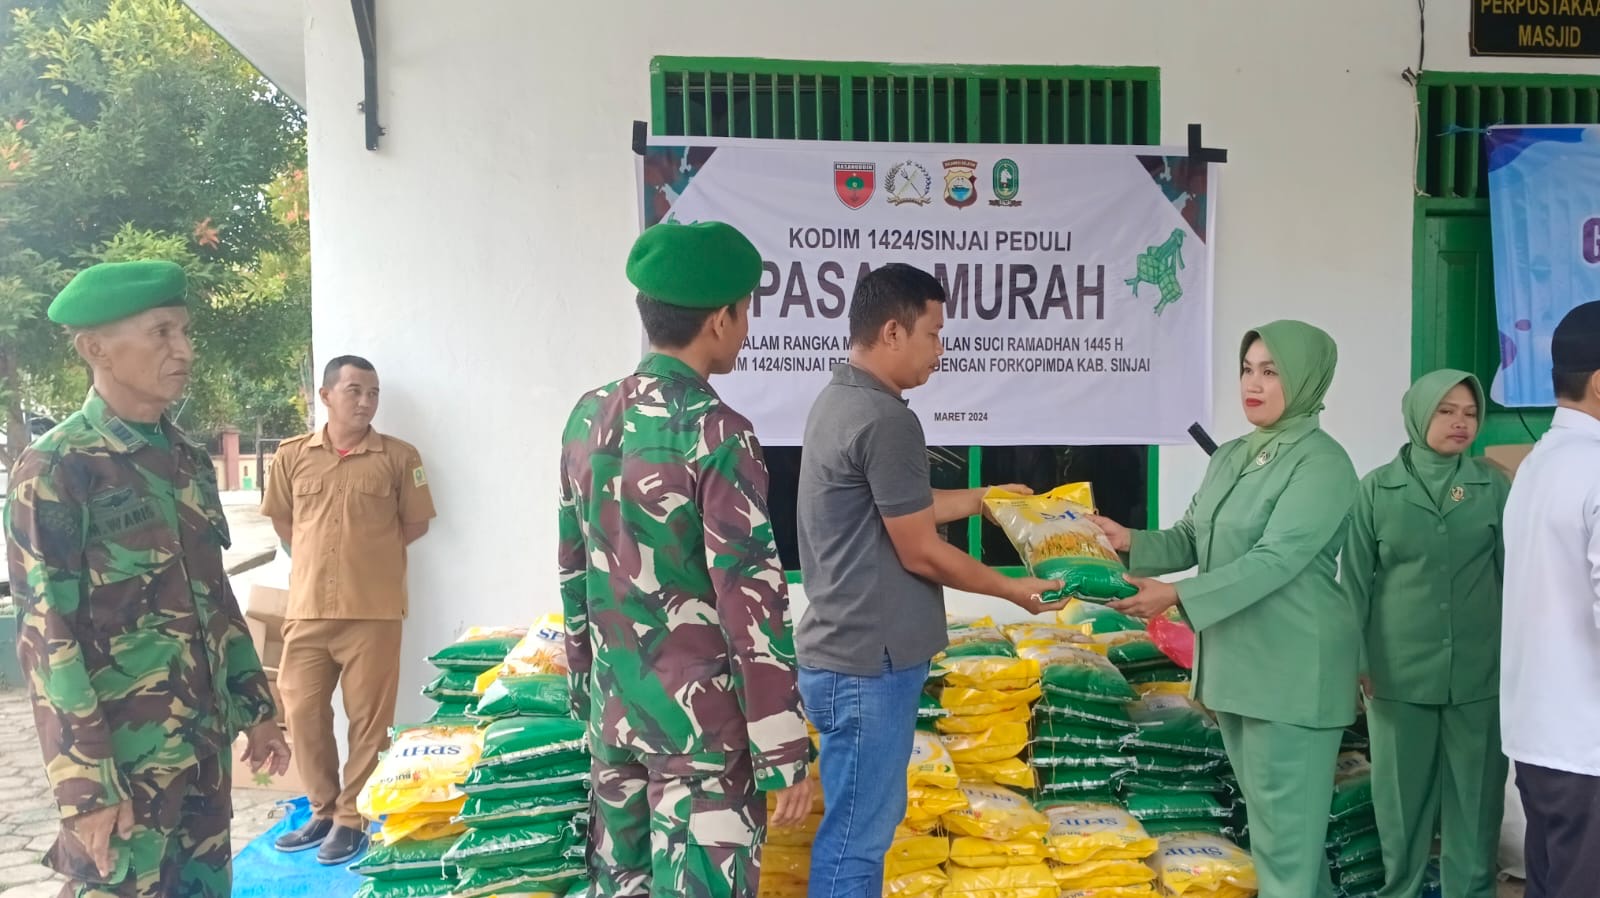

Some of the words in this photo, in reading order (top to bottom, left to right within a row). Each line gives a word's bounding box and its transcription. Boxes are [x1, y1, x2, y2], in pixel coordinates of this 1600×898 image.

[1519, 25, 1581, 47] MASJID
[789, 227, 860, 249] KODIM
[867, 229, 988, 251] 1424/SINJAI
[996, 231, 1072, 252] PEDULI
[752, 261, 873, 319] PAS
[934, 263, 1105, 320] MURAH
[742, 335, 780, 351] ALAM
[783, 336, 840, 351] RANGKA
[974, 337, 1004, 352] SUCI
[1007, 337, 1080, 352] RAMADHAN
[1084, 337, 1112, 352] 1445
[1114, 338, 1124, 352] H
[751, 357, 825, 372] 1424/SINJAI
[989, 358, 1074, 373] FORKOPIMDA
[1077, 358, 1108, 373] KAB.
[1110, 358, 1150, 373] SINJAI
[934, 412, 966, 421] MARET
[968, 412, 988, 421] 2024
